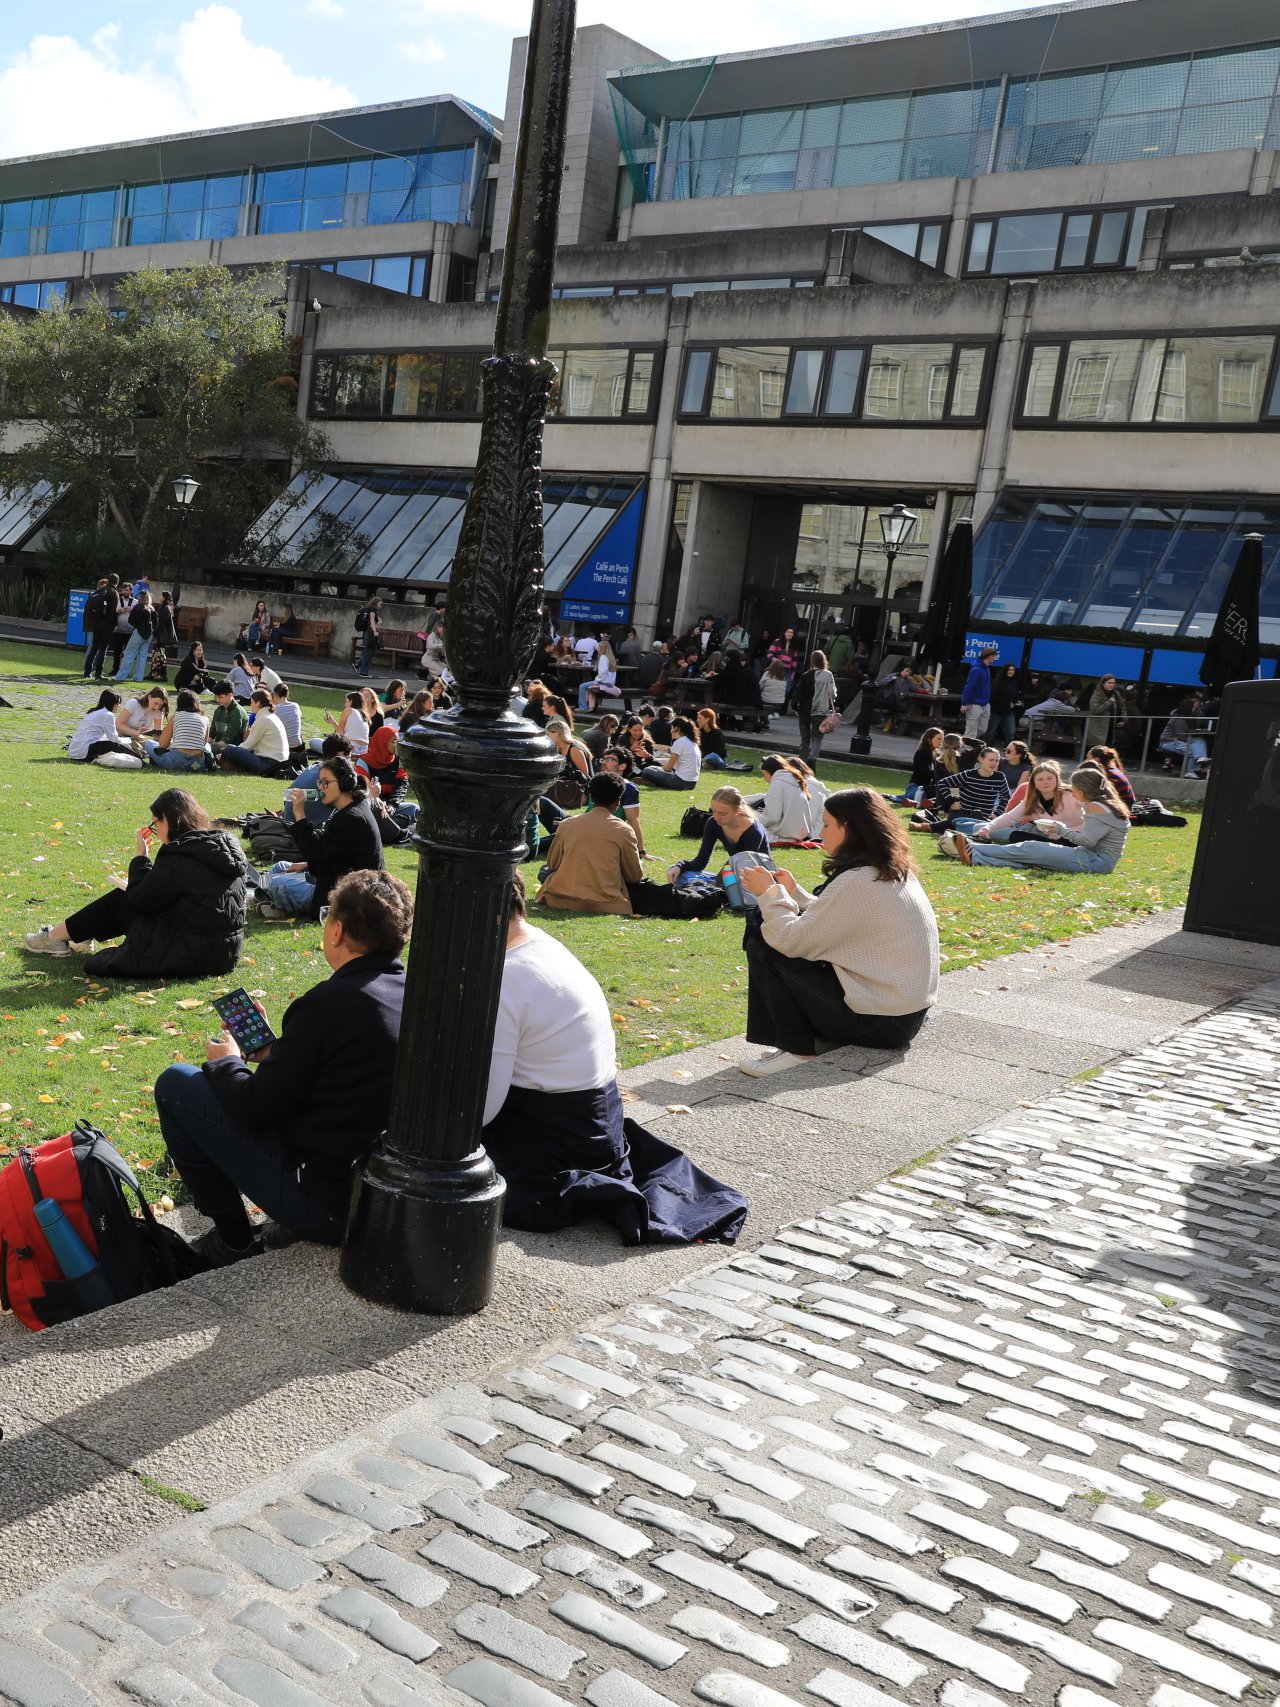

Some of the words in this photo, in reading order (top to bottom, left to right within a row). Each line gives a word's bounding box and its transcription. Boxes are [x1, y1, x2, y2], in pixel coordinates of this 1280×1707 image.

[593, 573, 602, 582] The
[603, 574, 616, 583] Perch
[971, 638, 999, 649] Perch
